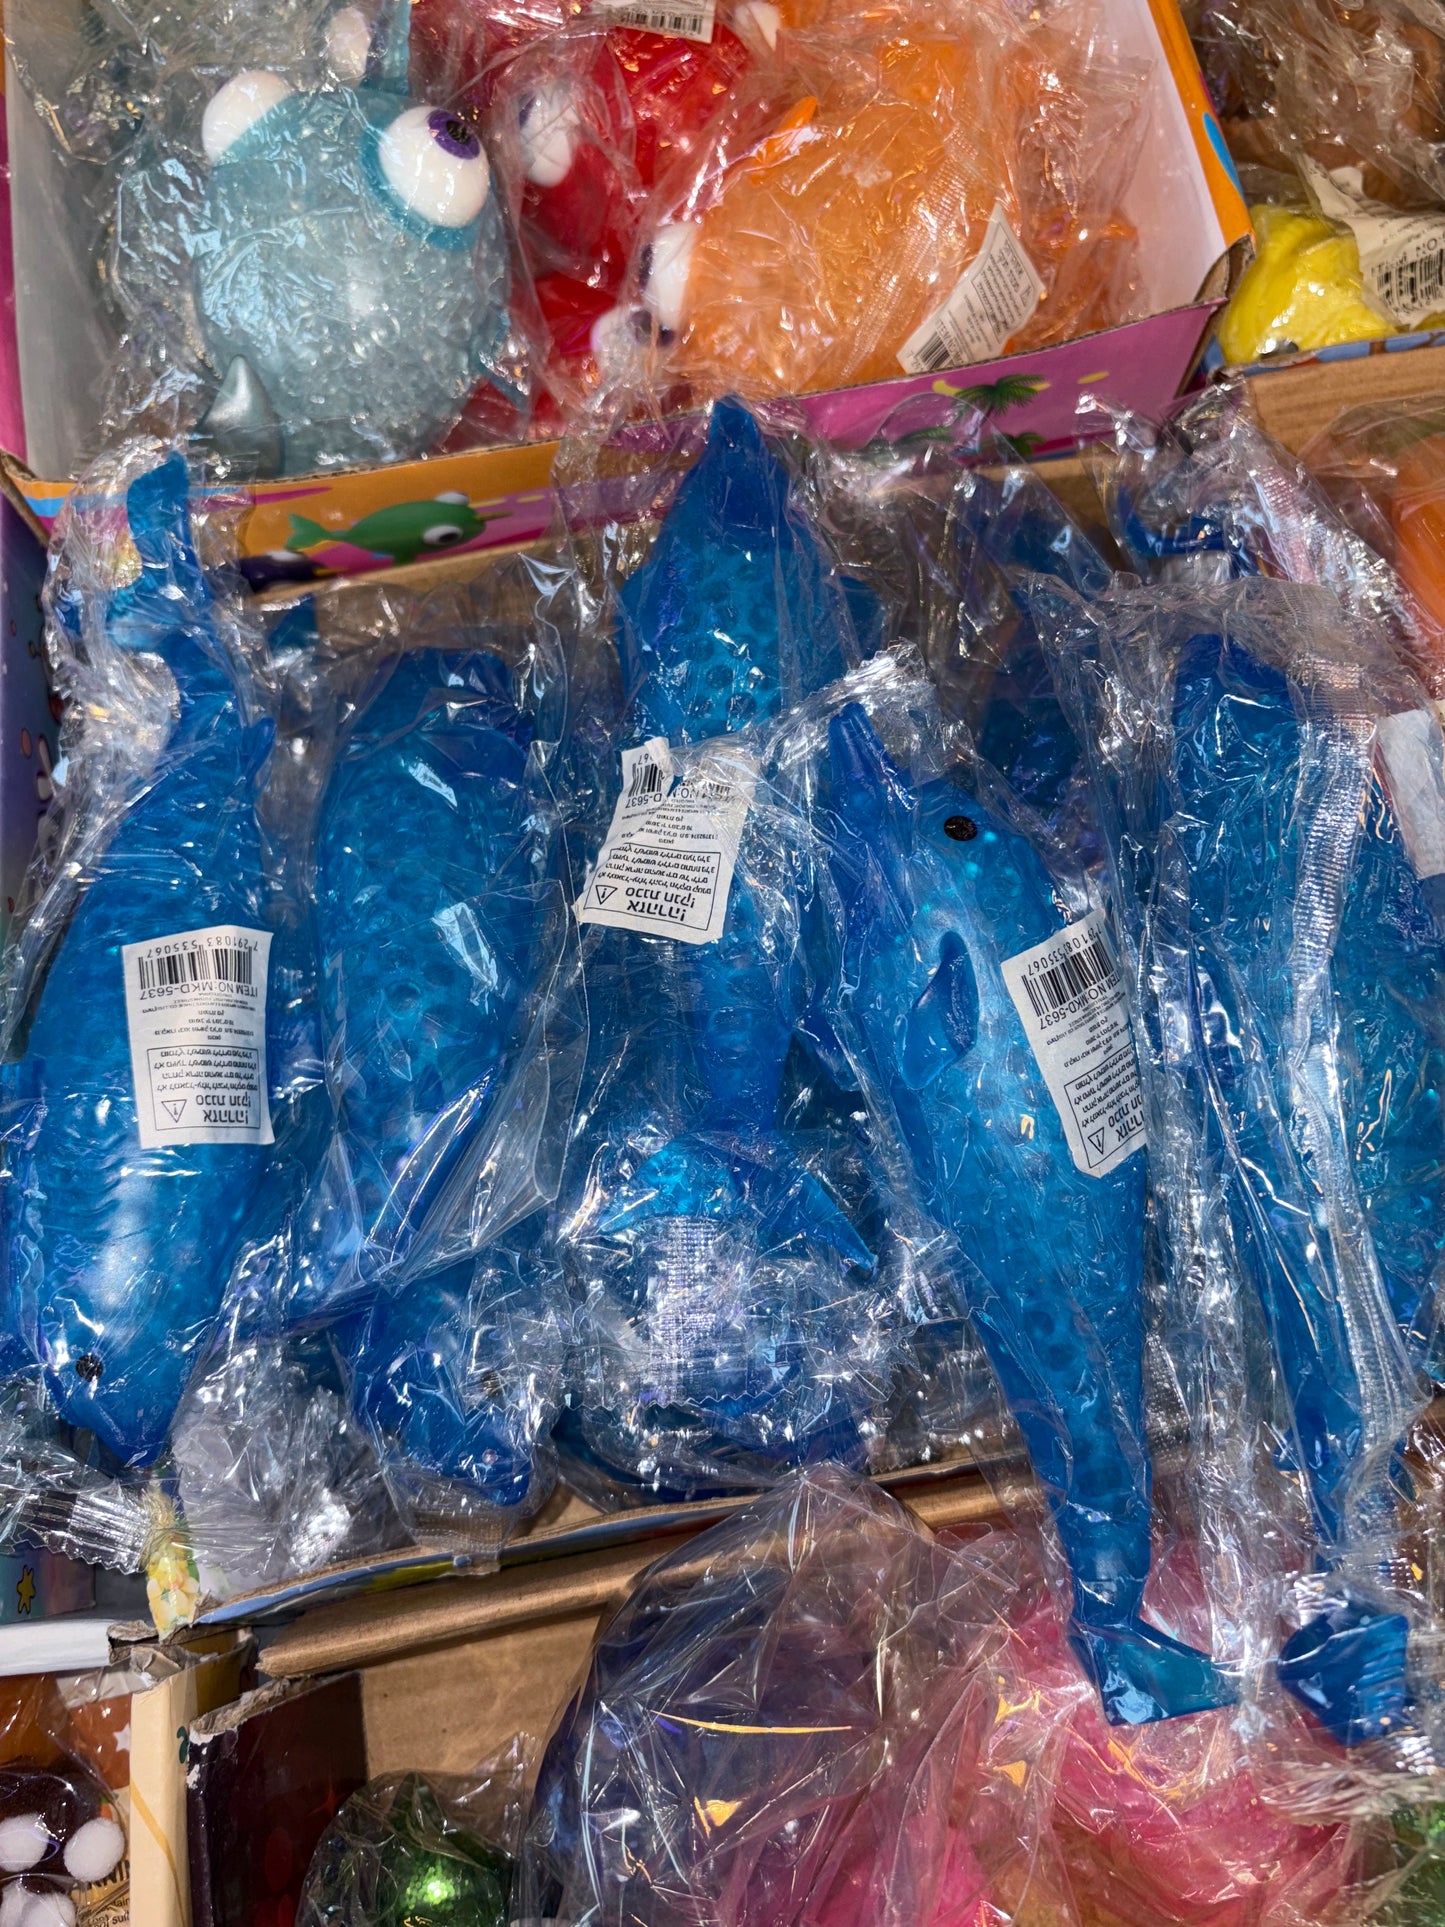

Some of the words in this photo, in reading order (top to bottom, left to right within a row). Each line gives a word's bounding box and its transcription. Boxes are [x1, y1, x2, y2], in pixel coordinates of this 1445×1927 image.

[633, 846, 658, 857] לשימוש
[659, 850, 682, 860] לילדים
[631, 855, 656, 867] לשימוש
[656, 859, 679, 870] לילדים
[624, 865, 643, 873] אריזה
[644, 867, 665, 877] מהישג
[678, 873, 689, 882] של
[690, 875, 708, 884] ילדים
[648, 877, 668, 887] להכיל
[668, 880, 691, 892] חלקים
[625, 885, 661, 901] סכנת
[663, 888, 696, 908] חנק!
[626, 898, 686, 922] אזהרה!
[146, 940, 197, 957] 535067
[206, 936, 248, 949] 291083
[1025, 947, 1063, 976] 535067
[235, 984, 257, 997] ITEM
[195, 1094, 225, 1106] סכנת
[229, 1092, 250, 1106] חנק!
[202, 1110, 248, 1124] אזהרה!
[1105, 1102, 1132, 1128] סכנת
[1128, 1094, 1143, 1110] חנ
[1080, 1118, 1090, 1128] לא
